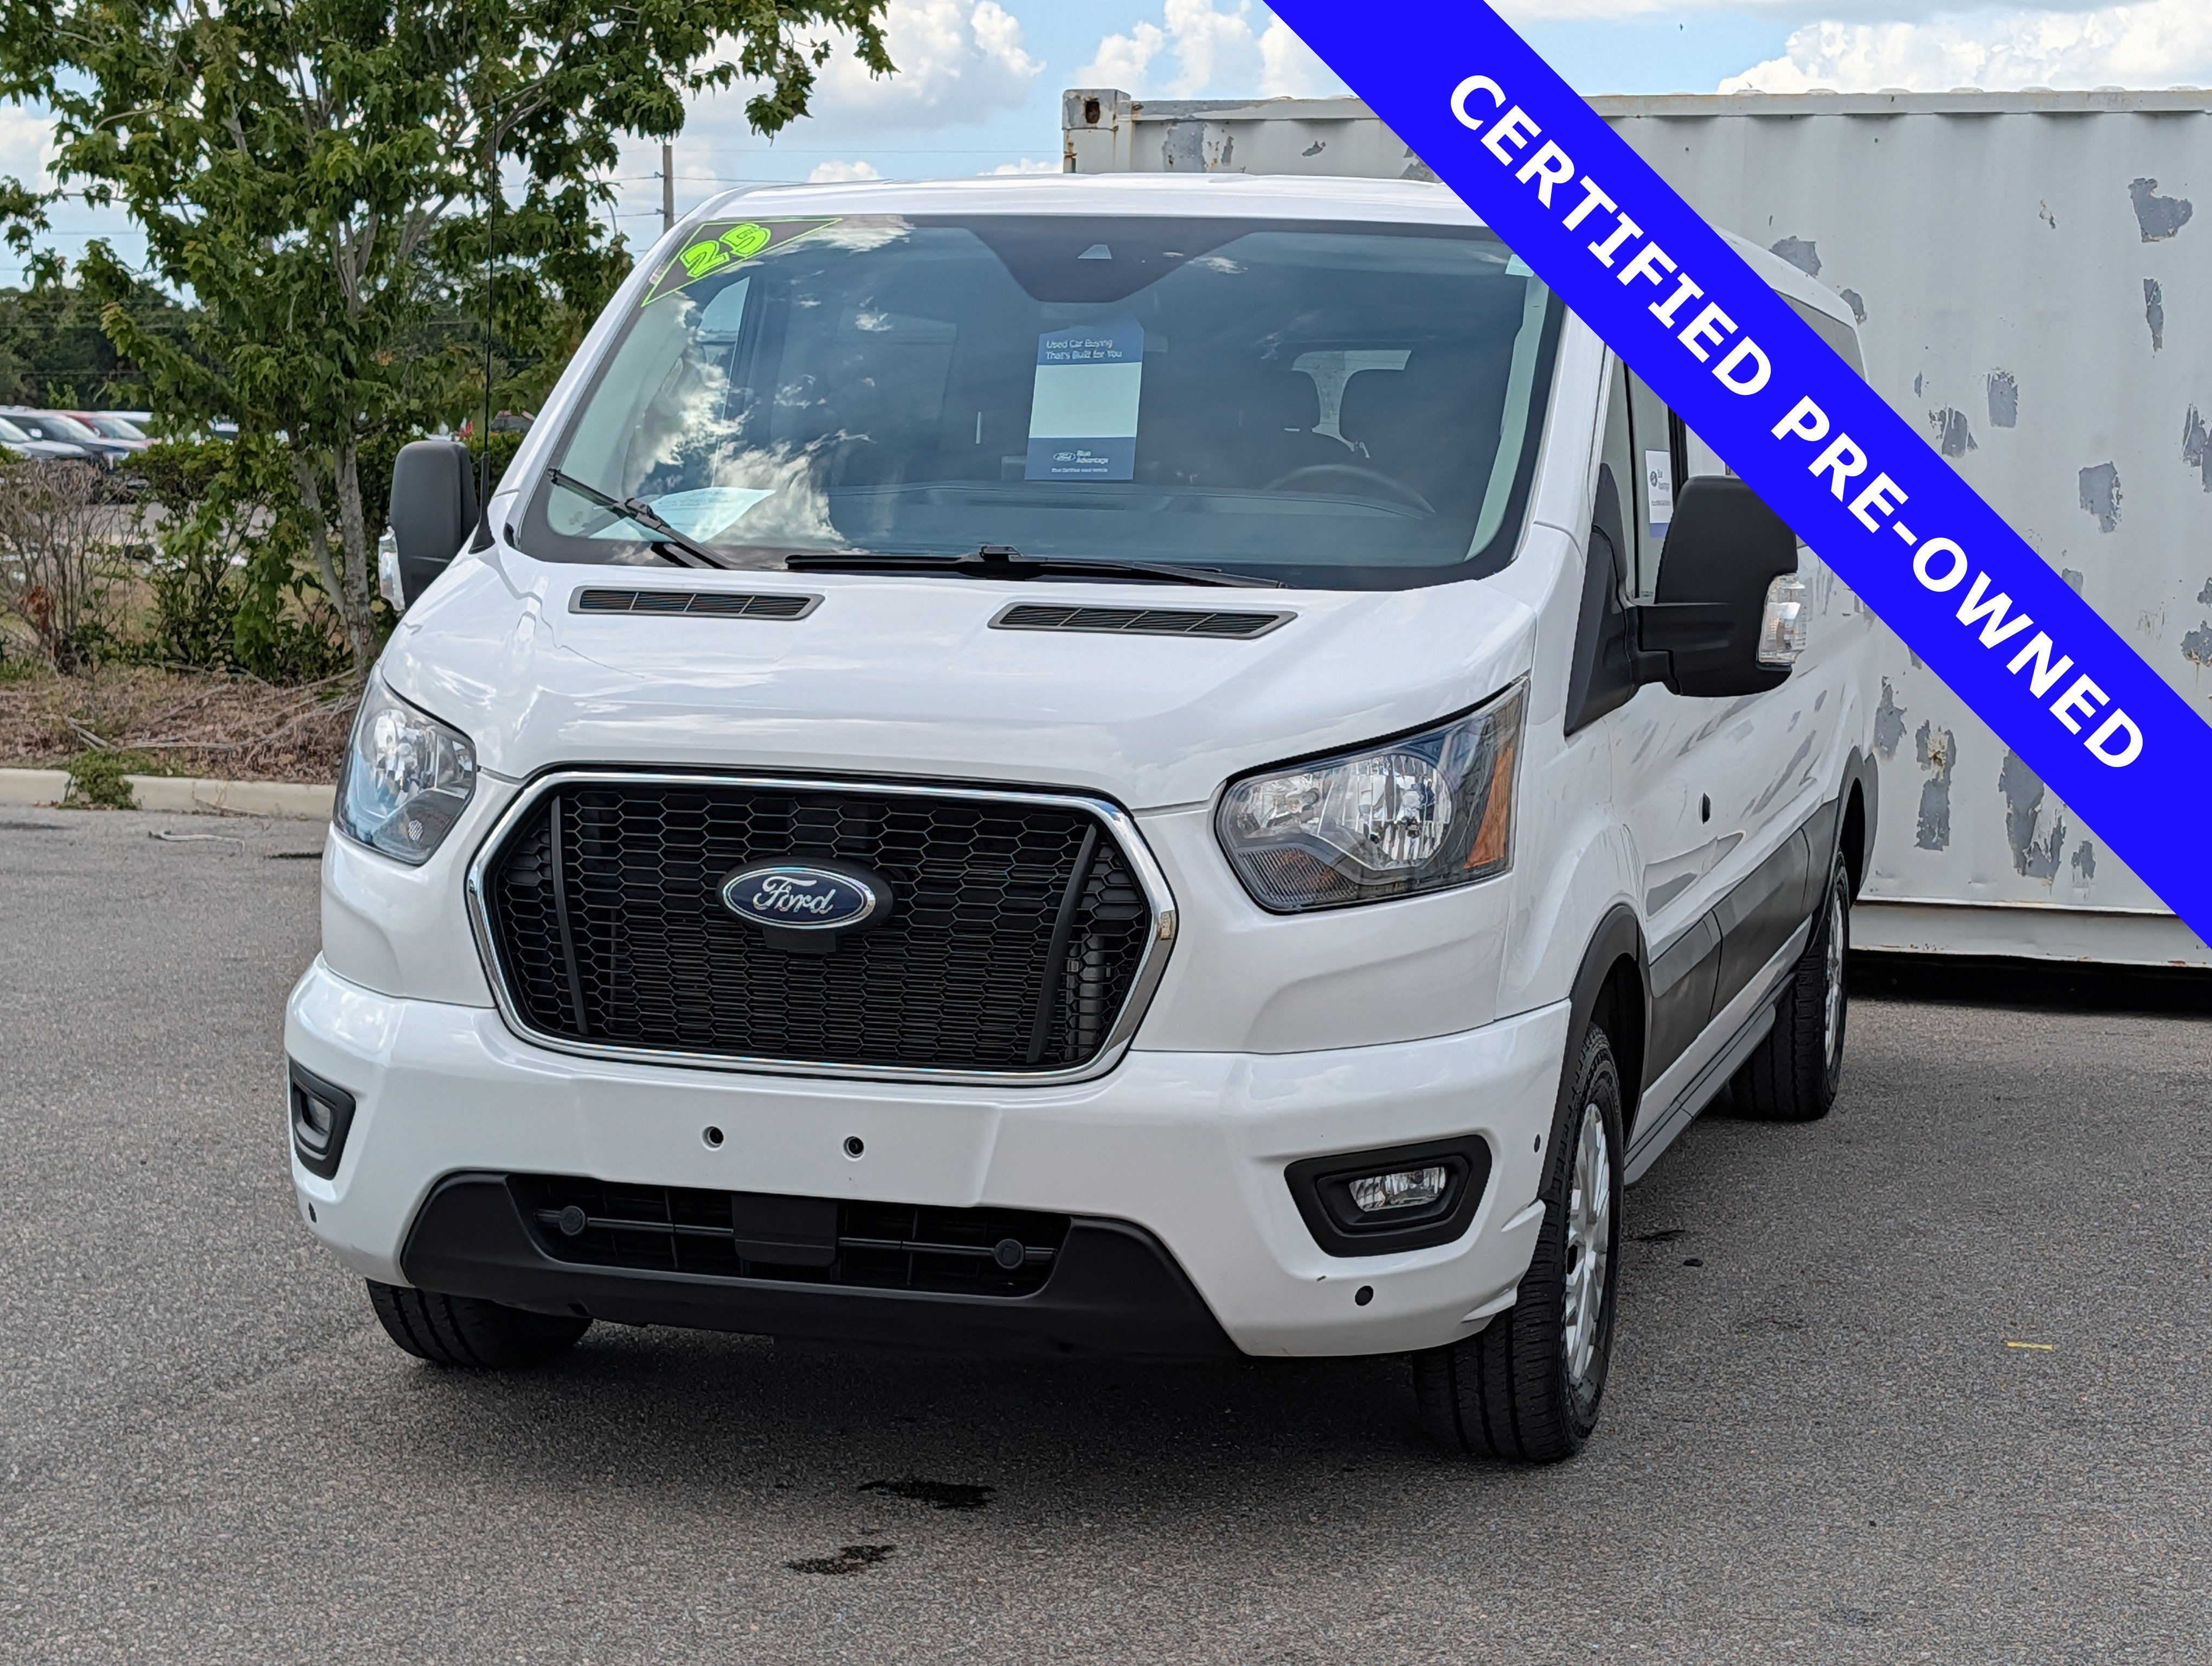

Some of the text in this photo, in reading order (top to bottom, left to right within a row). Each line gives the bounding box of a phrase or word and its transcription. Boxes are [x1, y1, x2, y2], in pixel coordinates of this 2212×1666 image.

[1046, 338, 1113, 349] Used Car Buying
[1046, 351, 1070, 360] That's
[1072, 350, 1091, 359] Built
[1092, 349, 1105, 358] for
[753, 875, 836, 915] Ford
